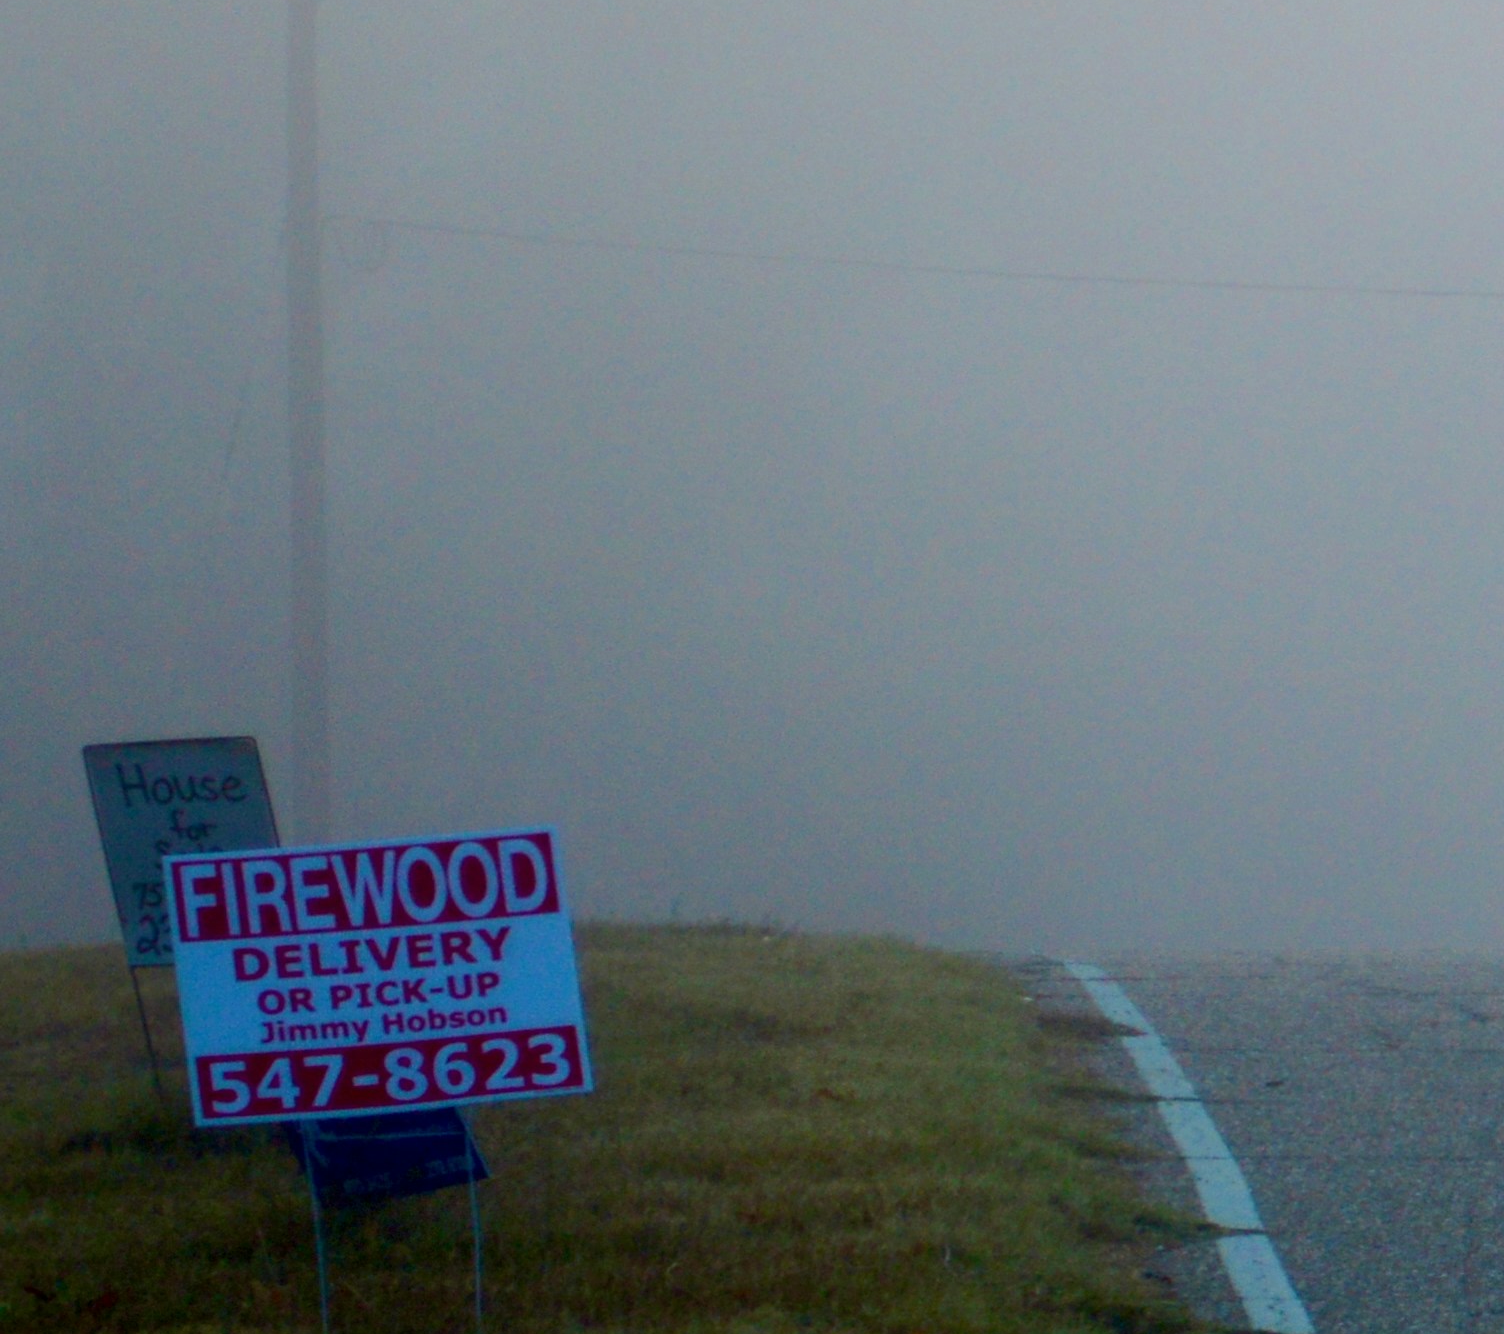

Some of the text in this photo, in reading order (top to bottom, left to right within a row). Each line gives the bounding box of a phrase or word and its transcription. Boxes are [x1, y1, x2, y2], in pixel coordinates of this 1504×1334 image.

[115, 762, 246, 807] House
[168, 809, 216, 840] for
[180, 838, 548, 938] FIREWOOD
[232, 926, 513, 982] DELIVERY
[256, 972, 500, 1015] OR PICK-UP
[260, 1006, 508, 1046] Jimmy Hobson
[208, 1033, 570, 1114] 547-8623
